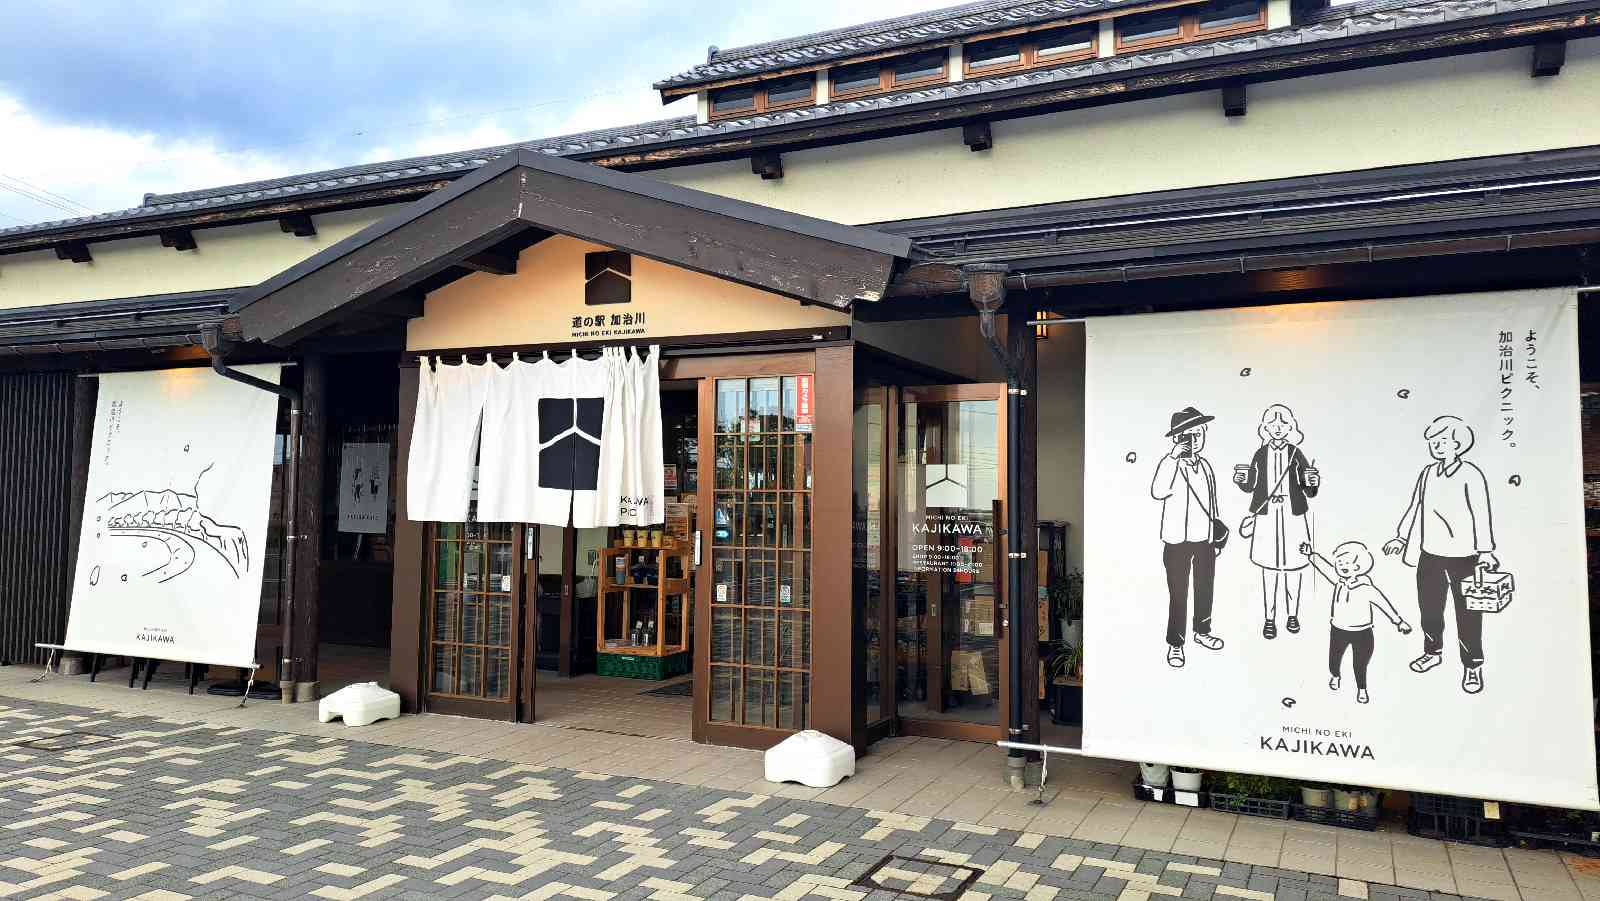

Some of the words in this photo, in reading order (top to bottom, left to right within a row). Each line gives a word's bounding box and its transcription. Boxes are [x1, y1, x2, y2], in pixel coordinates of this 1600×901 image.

[572, 314, 605, 328] 道の駅
[610, 312, 645, 326] 加治川
[1525, 329, 1540, 390] ようこそ、
[1498, 330, 1516, 448] 加治川ピクニック。
[912, 523, 982, 535] KAJIKAWA
[912, 544, 935, 552] OPEN
[1282, 726, 1311, 735] MICHI
[1315, 728, 1331, 737] NO
[1334, 730, 1352, 738] EKI
[1260, 736, 1375, 760] KAJIKAWA
